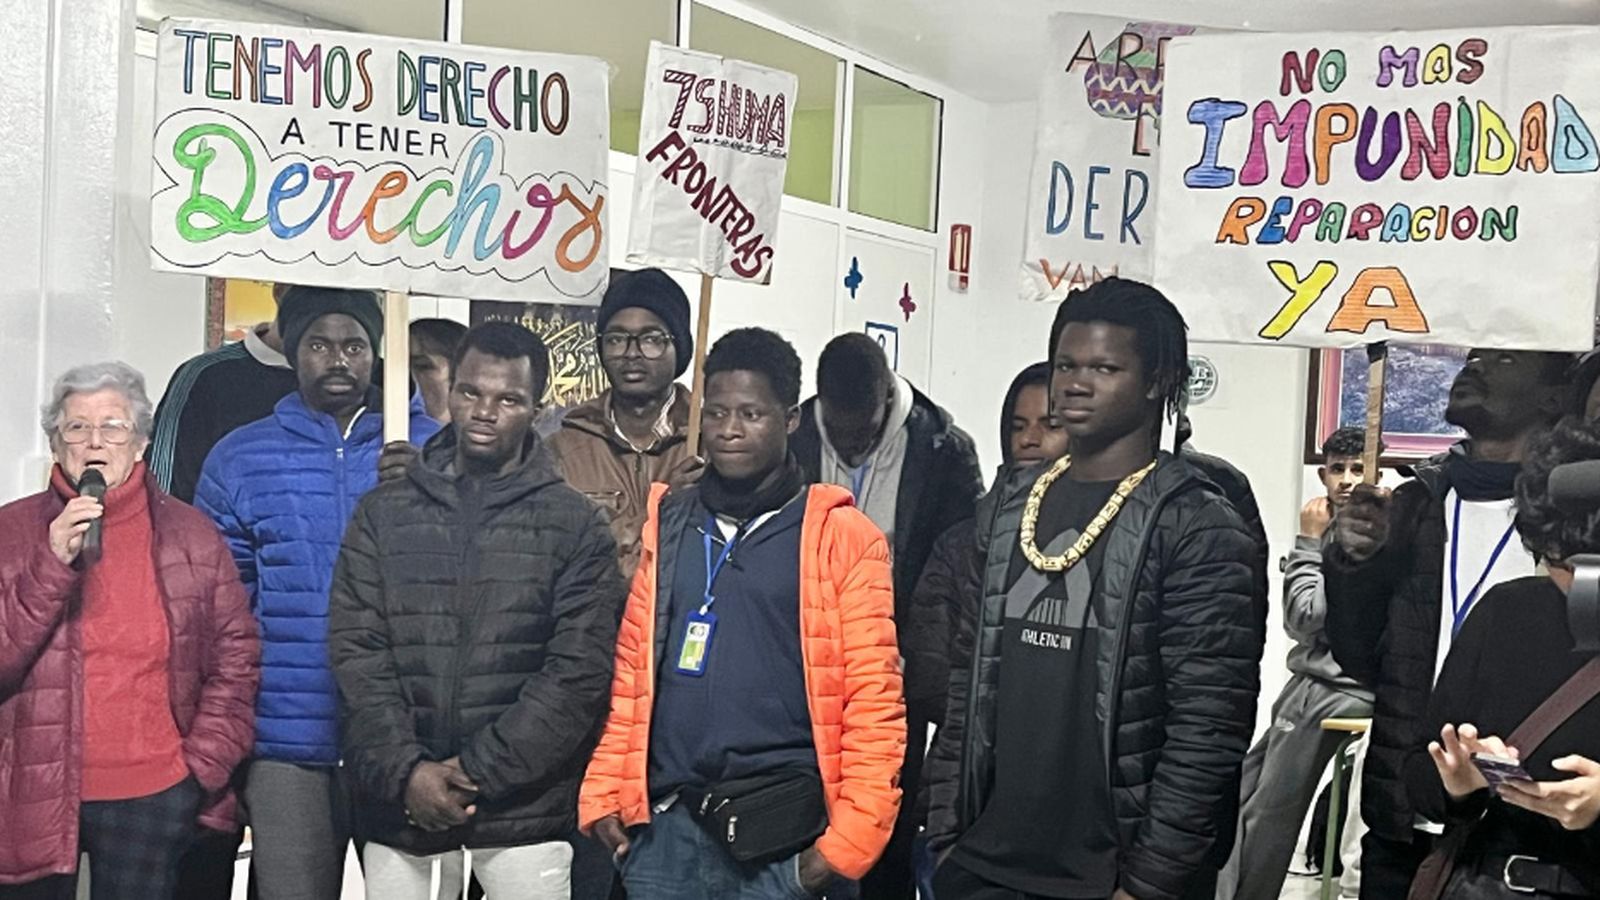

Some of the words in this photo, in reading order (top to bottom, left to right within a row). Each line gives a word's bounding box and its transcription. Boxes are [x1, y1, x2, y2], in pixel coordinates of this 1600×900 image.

[174, 29, 372, 112] TENEMOS
[397, 50, 570, 136] DERECHO
[1279, 48, 1346, 96] NO
[1376, 38, 1488, 87] MAS
[281, 117, 305, 145] A
[329, 121, 449, 159] TENER
[1183, 94, 1600, 188] IMPUNIDAD
[646, 130, 774, 278] FRONTERAS
[1215, 196, 1518, 244] REPARACION
[1258, 260, 1430, 340] YA
